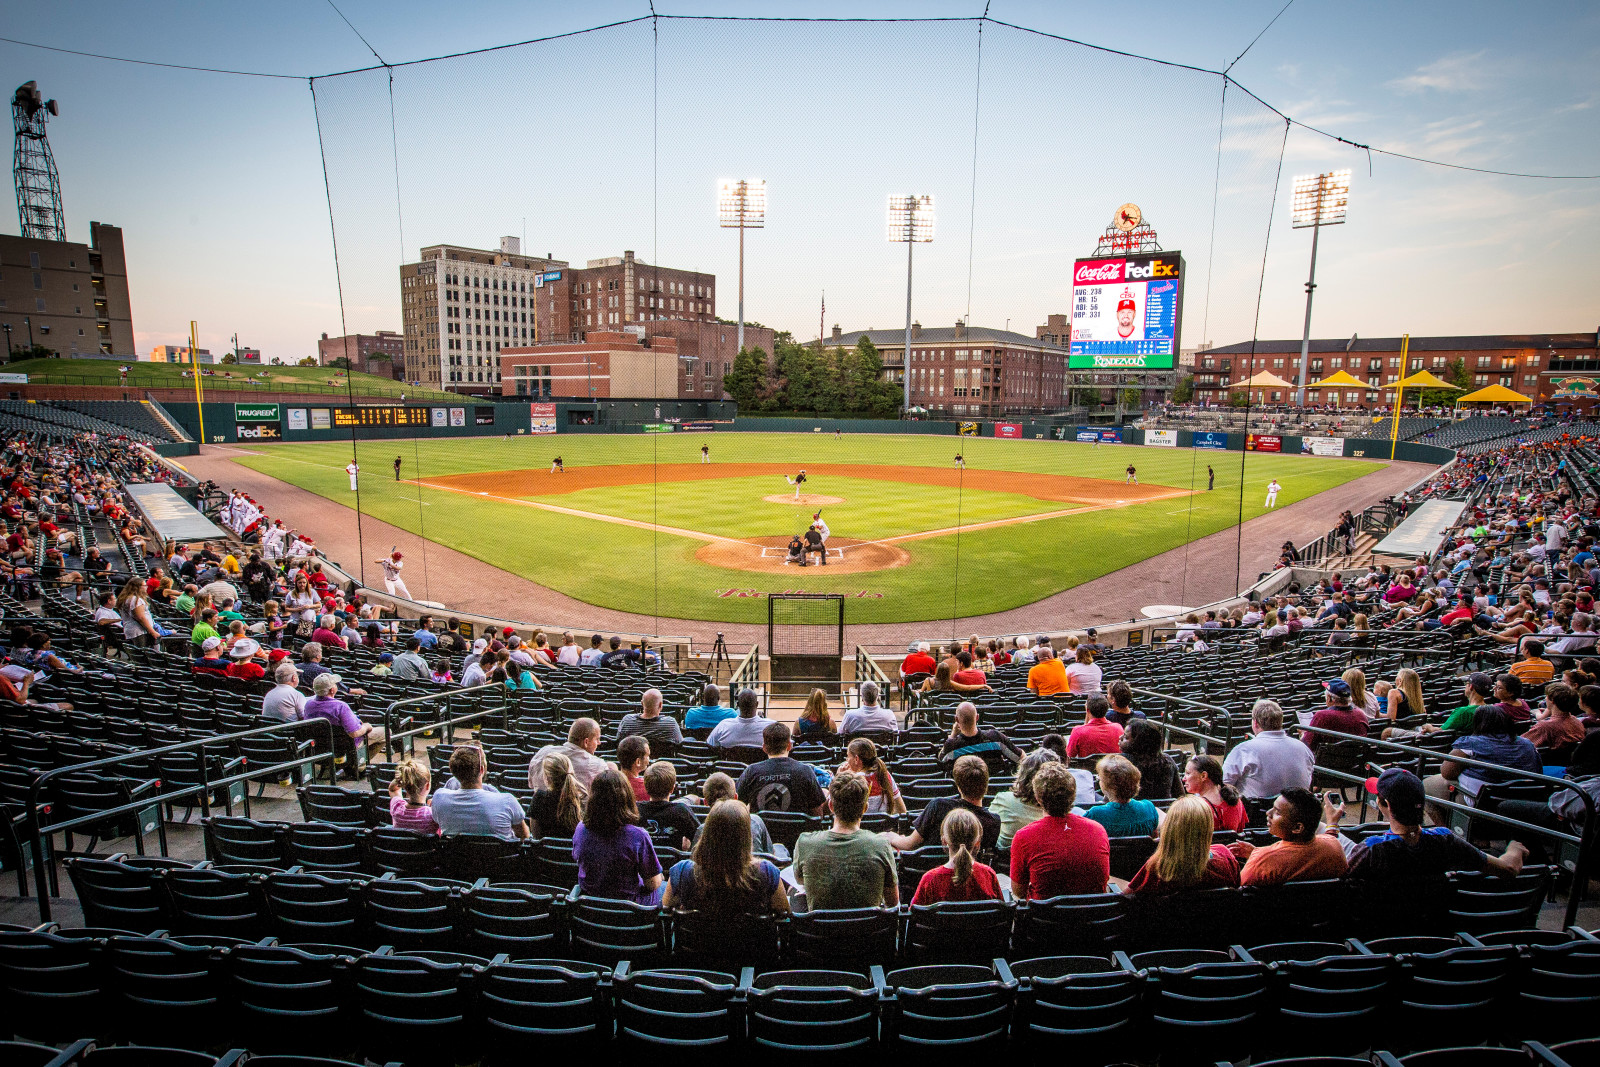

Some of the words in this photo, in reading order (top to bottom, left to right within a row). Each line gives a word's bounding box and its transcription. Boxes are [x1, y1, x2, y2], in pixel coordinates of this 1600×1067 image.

[1099, 230, 1157, 243] AUTOZONE
[1112, 240, 1140, 250] PARK
[1076, 263, 1123, 282] Coca-Cola
[1072, 329, 1080, 340] 12
[237, 408, 276, 417] TRUGREEN
[760, 773, 791, 781] PORTER
